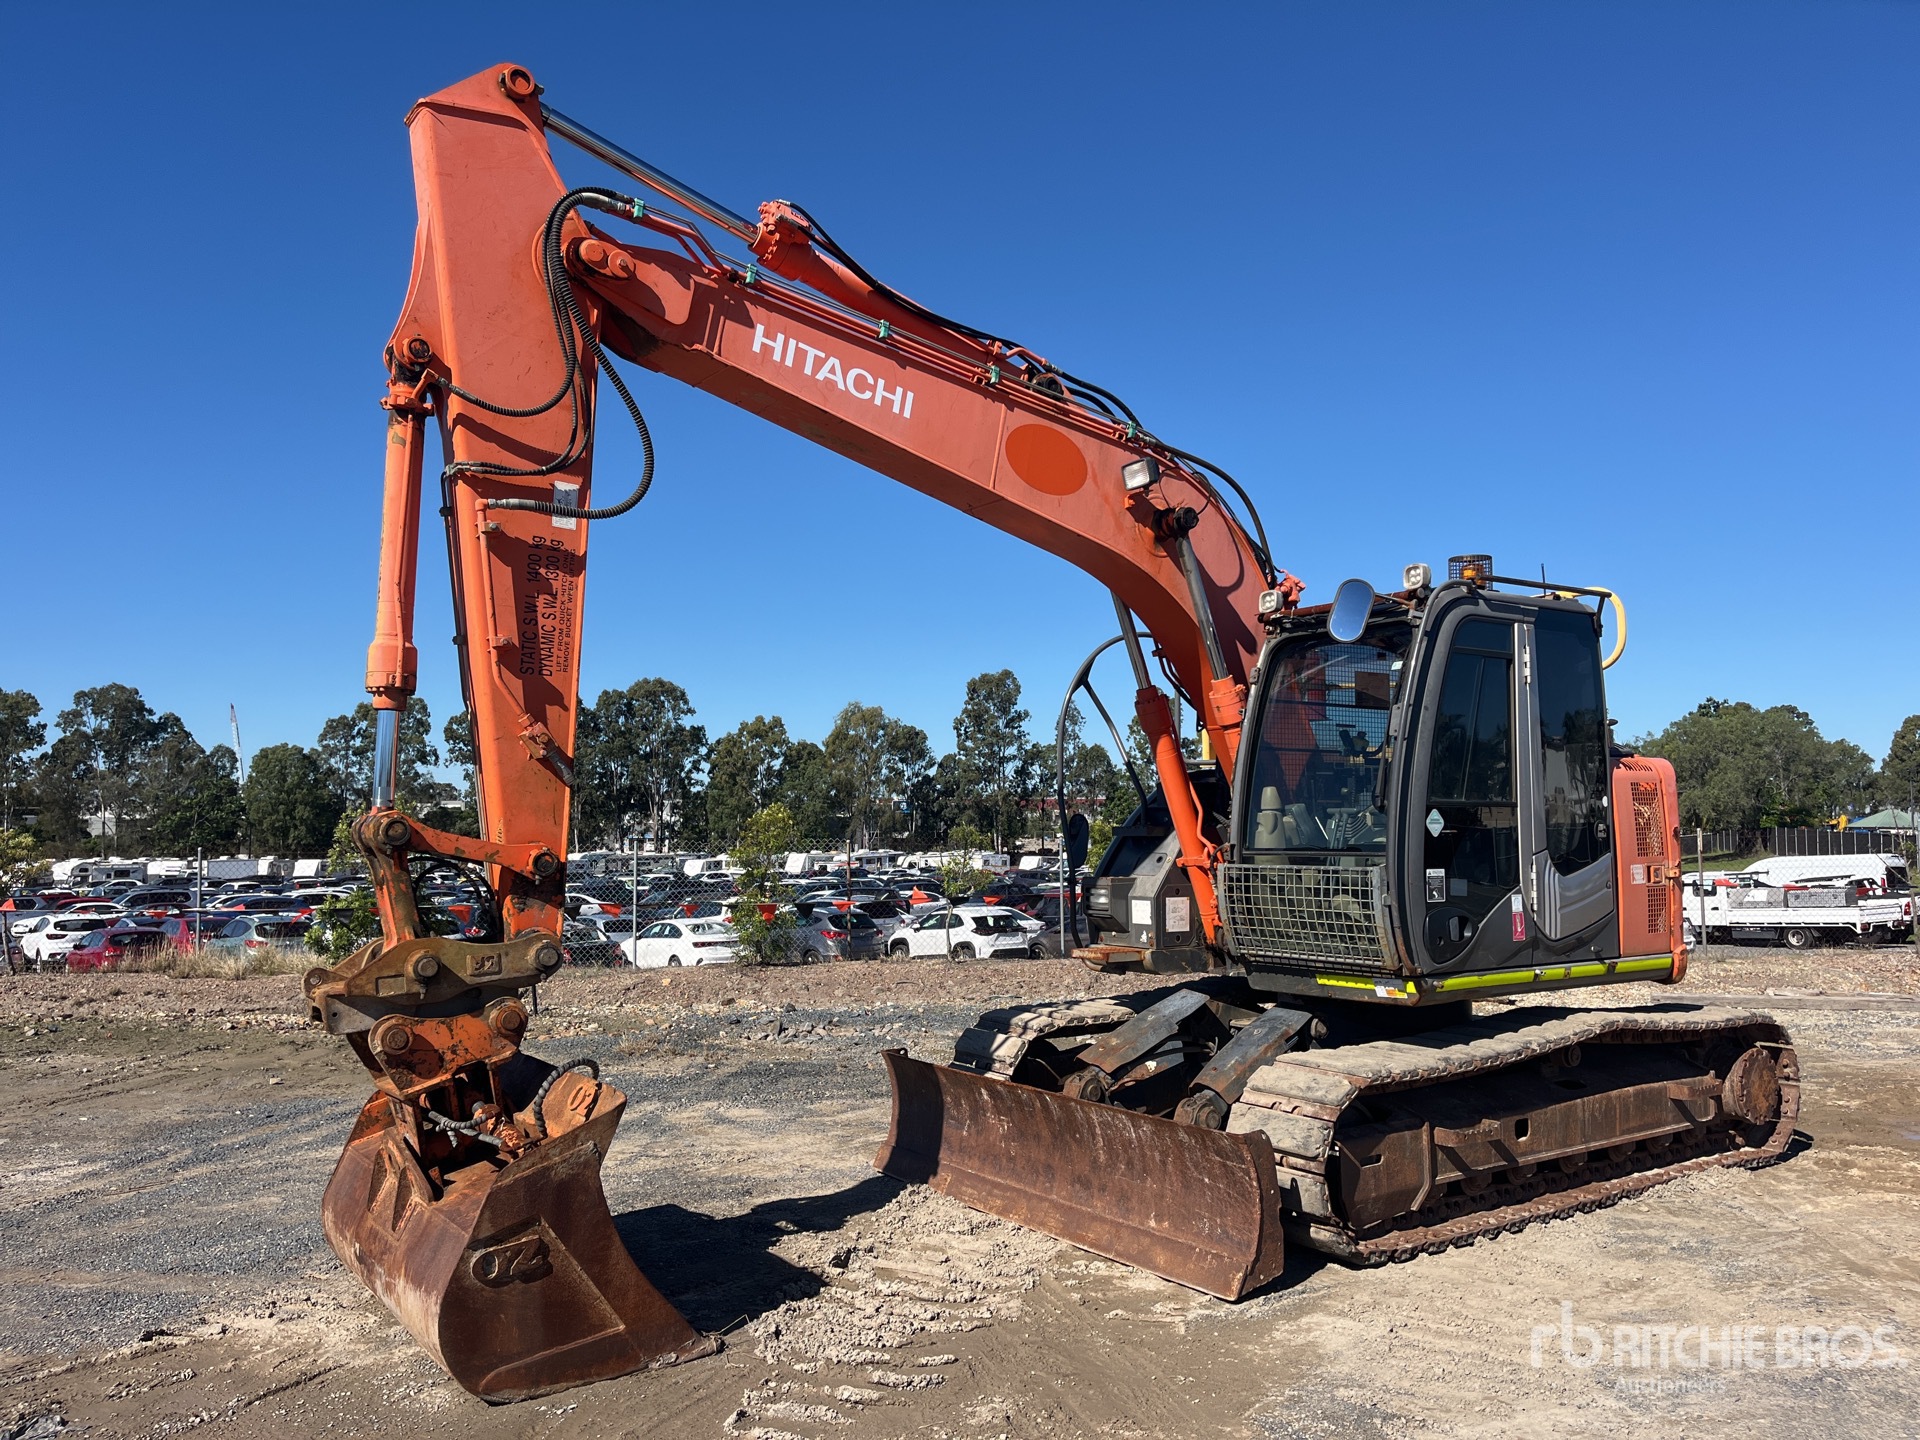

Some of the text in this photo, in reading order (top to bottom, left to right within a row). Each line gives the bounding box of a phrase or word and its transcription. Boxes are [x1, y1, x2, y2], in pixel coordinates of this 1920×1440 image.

[752, 323, 914, 419] HITACHI
[546, 539, 564, 552] kg
[545, 555, 560, 581] 1300
[519, 535, 546, 675] STATIC S.W.L. 1400 kg
[542, 587, 558, 621] S.W.L.
[539, 625, 556, 677] DYNAMIC
